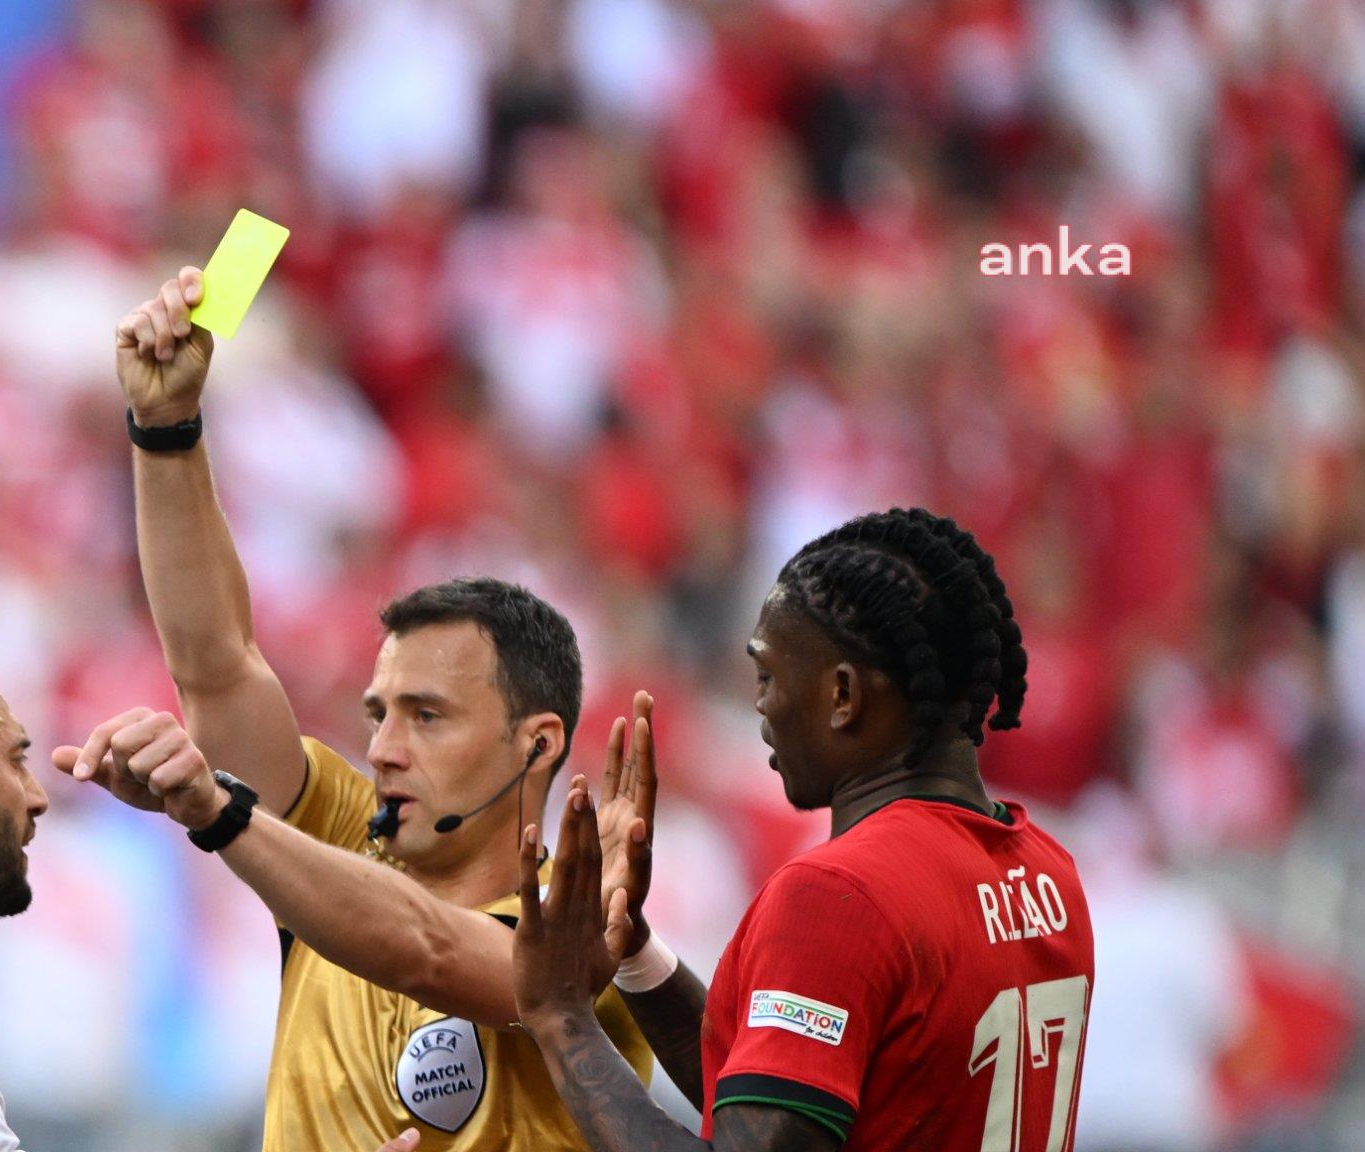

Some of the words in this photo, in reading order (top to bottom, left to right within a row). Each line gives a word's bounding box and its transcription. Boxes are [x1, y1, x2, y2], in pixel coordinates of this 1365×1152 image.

[410, 1032, 457, 1058] UEFA
[415, 1062, 465, 1085] MATCH
[412, 1078, 475, 1103] OFFICIAL
